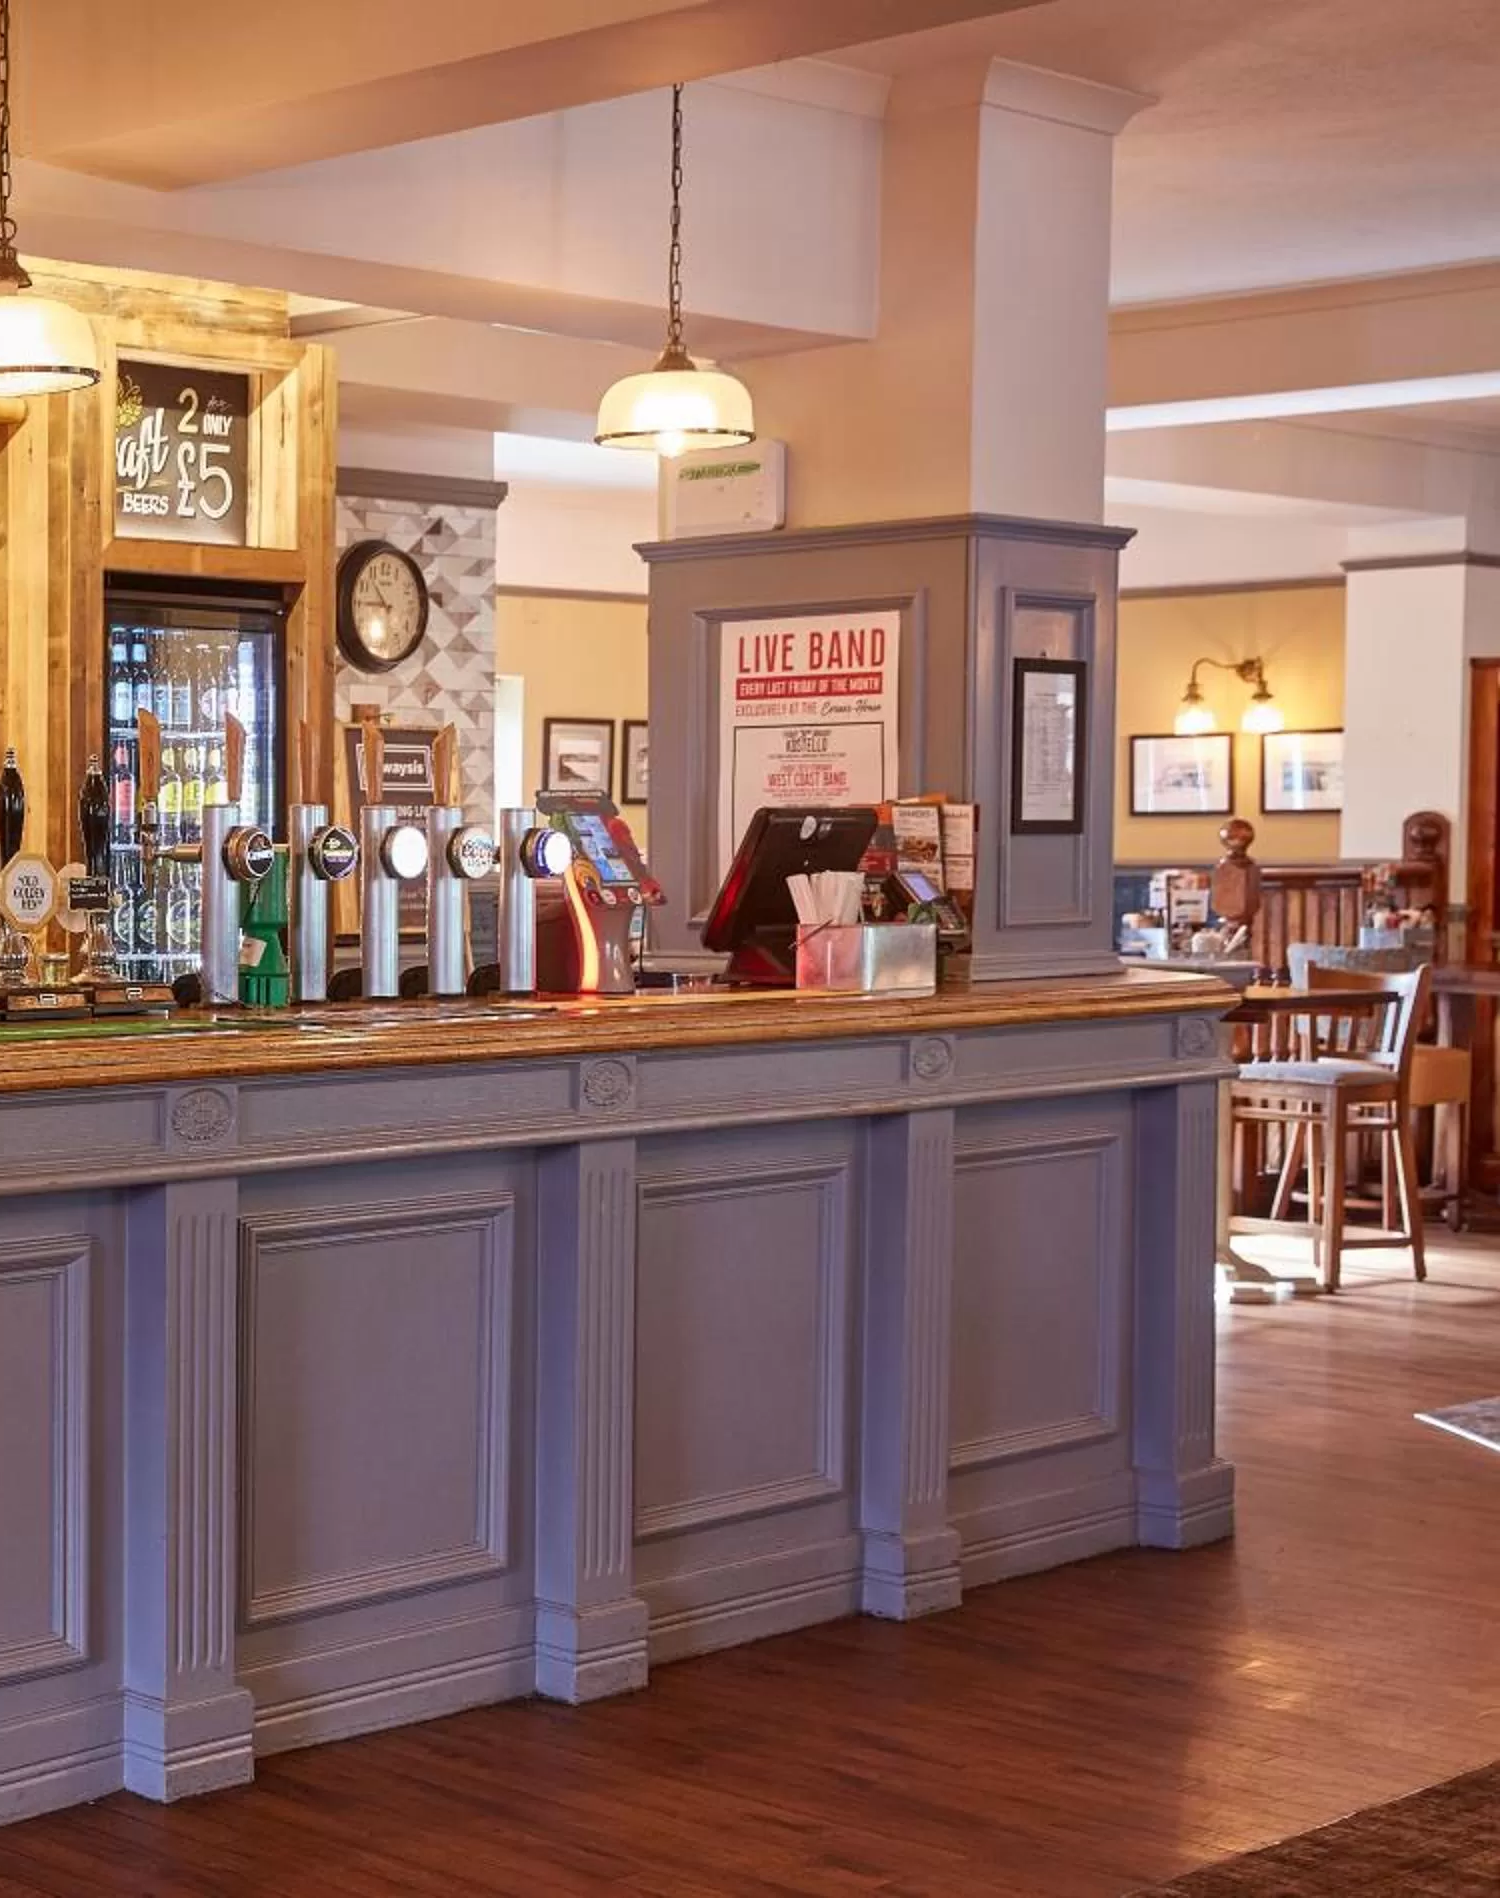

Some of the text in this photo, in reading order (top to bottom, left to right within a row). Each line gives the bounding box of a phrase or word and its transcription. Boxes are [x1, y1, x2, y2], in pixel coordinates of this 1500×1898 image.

[177, 387, 199, 433] 2
[203, 413, 233, 436] ONLY
[116, 407, 169, 491] aft
[176, 441, 233, 519] £5
[122, 493, 169, 516] BEERS
[738, 627, 886, 674] LIVE BAND
[739, 675, 878, 698] EVERY LAST FRIDAY OF THE MONTH
[735, 702, 786, 718] EXCLUSIVELY
[789, 701, 799, 716] AT
[800, 700, 818, 715] THE
[383, 759, 425, 777] waysis
